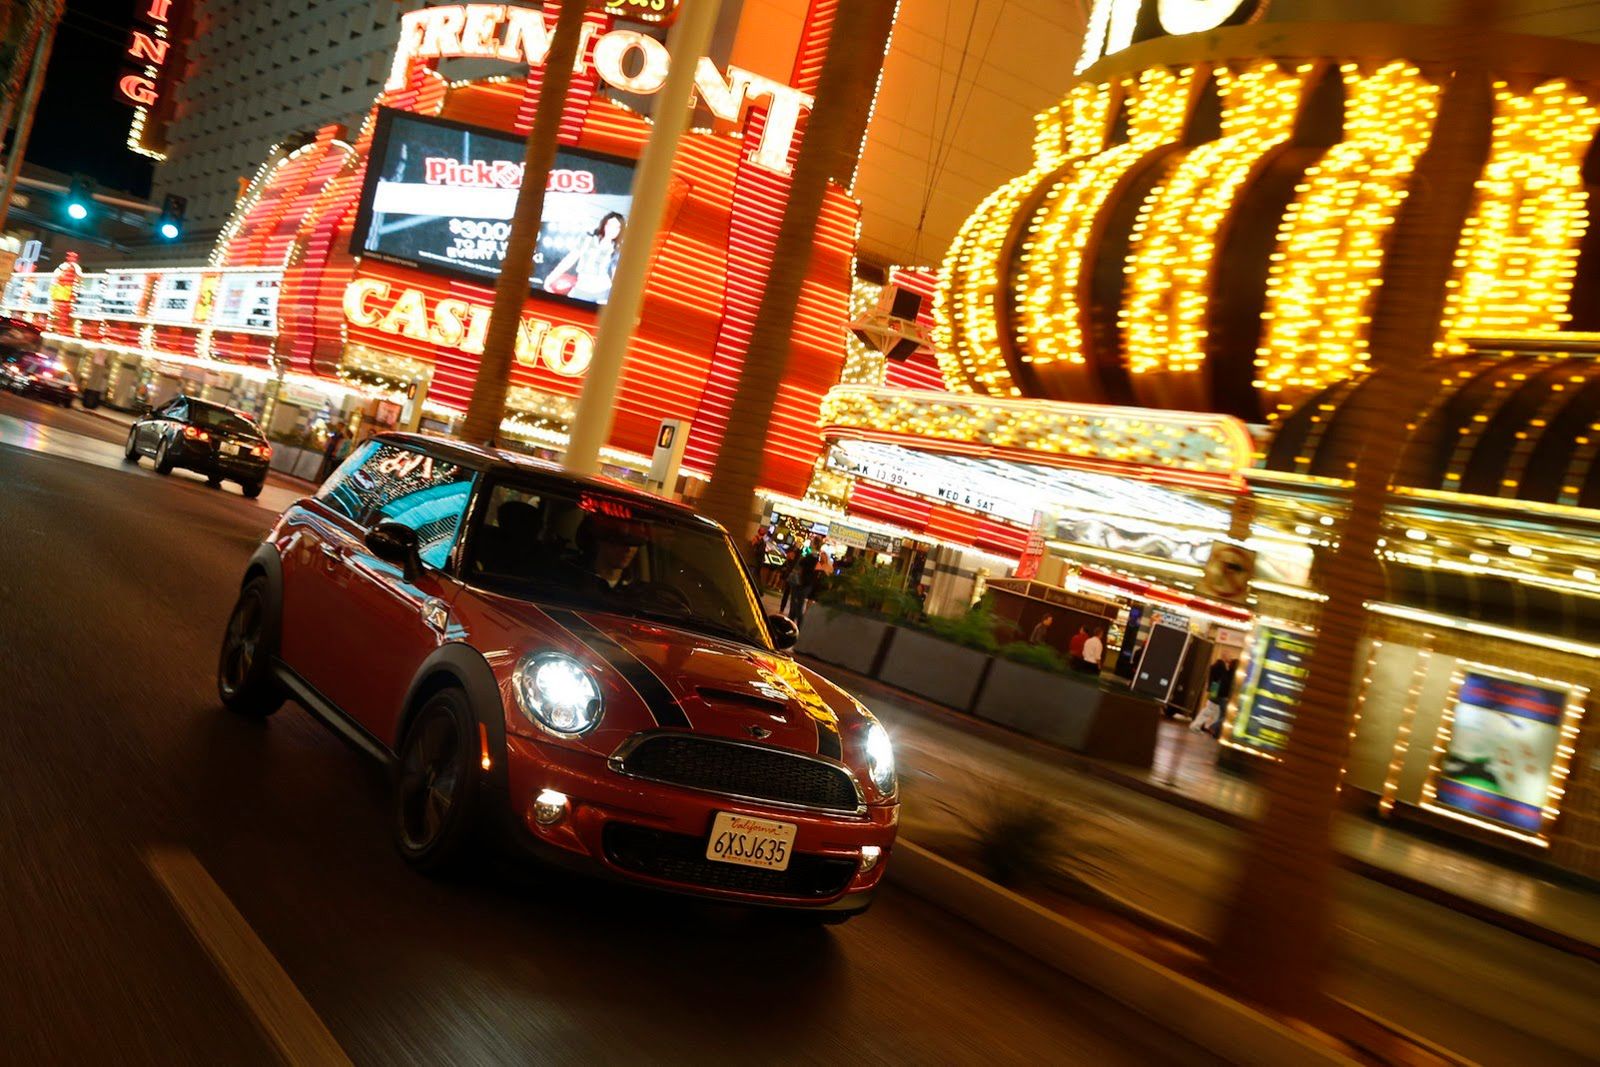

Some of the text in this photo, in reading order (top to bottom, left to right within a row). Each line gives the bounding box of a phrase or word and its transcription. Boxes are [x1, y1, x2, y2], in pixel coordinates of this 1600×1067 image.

[424, 157, 494, 187] Pick
[342, 277, 597, 377] CASINO
[938, 487, 959, 501] WED
[964, 496, 971, 505] &
[977, 499, 995, 511] SAT
[731, 817, 781, 836] California
[714, 831, 787, 863] 6XSJ635
